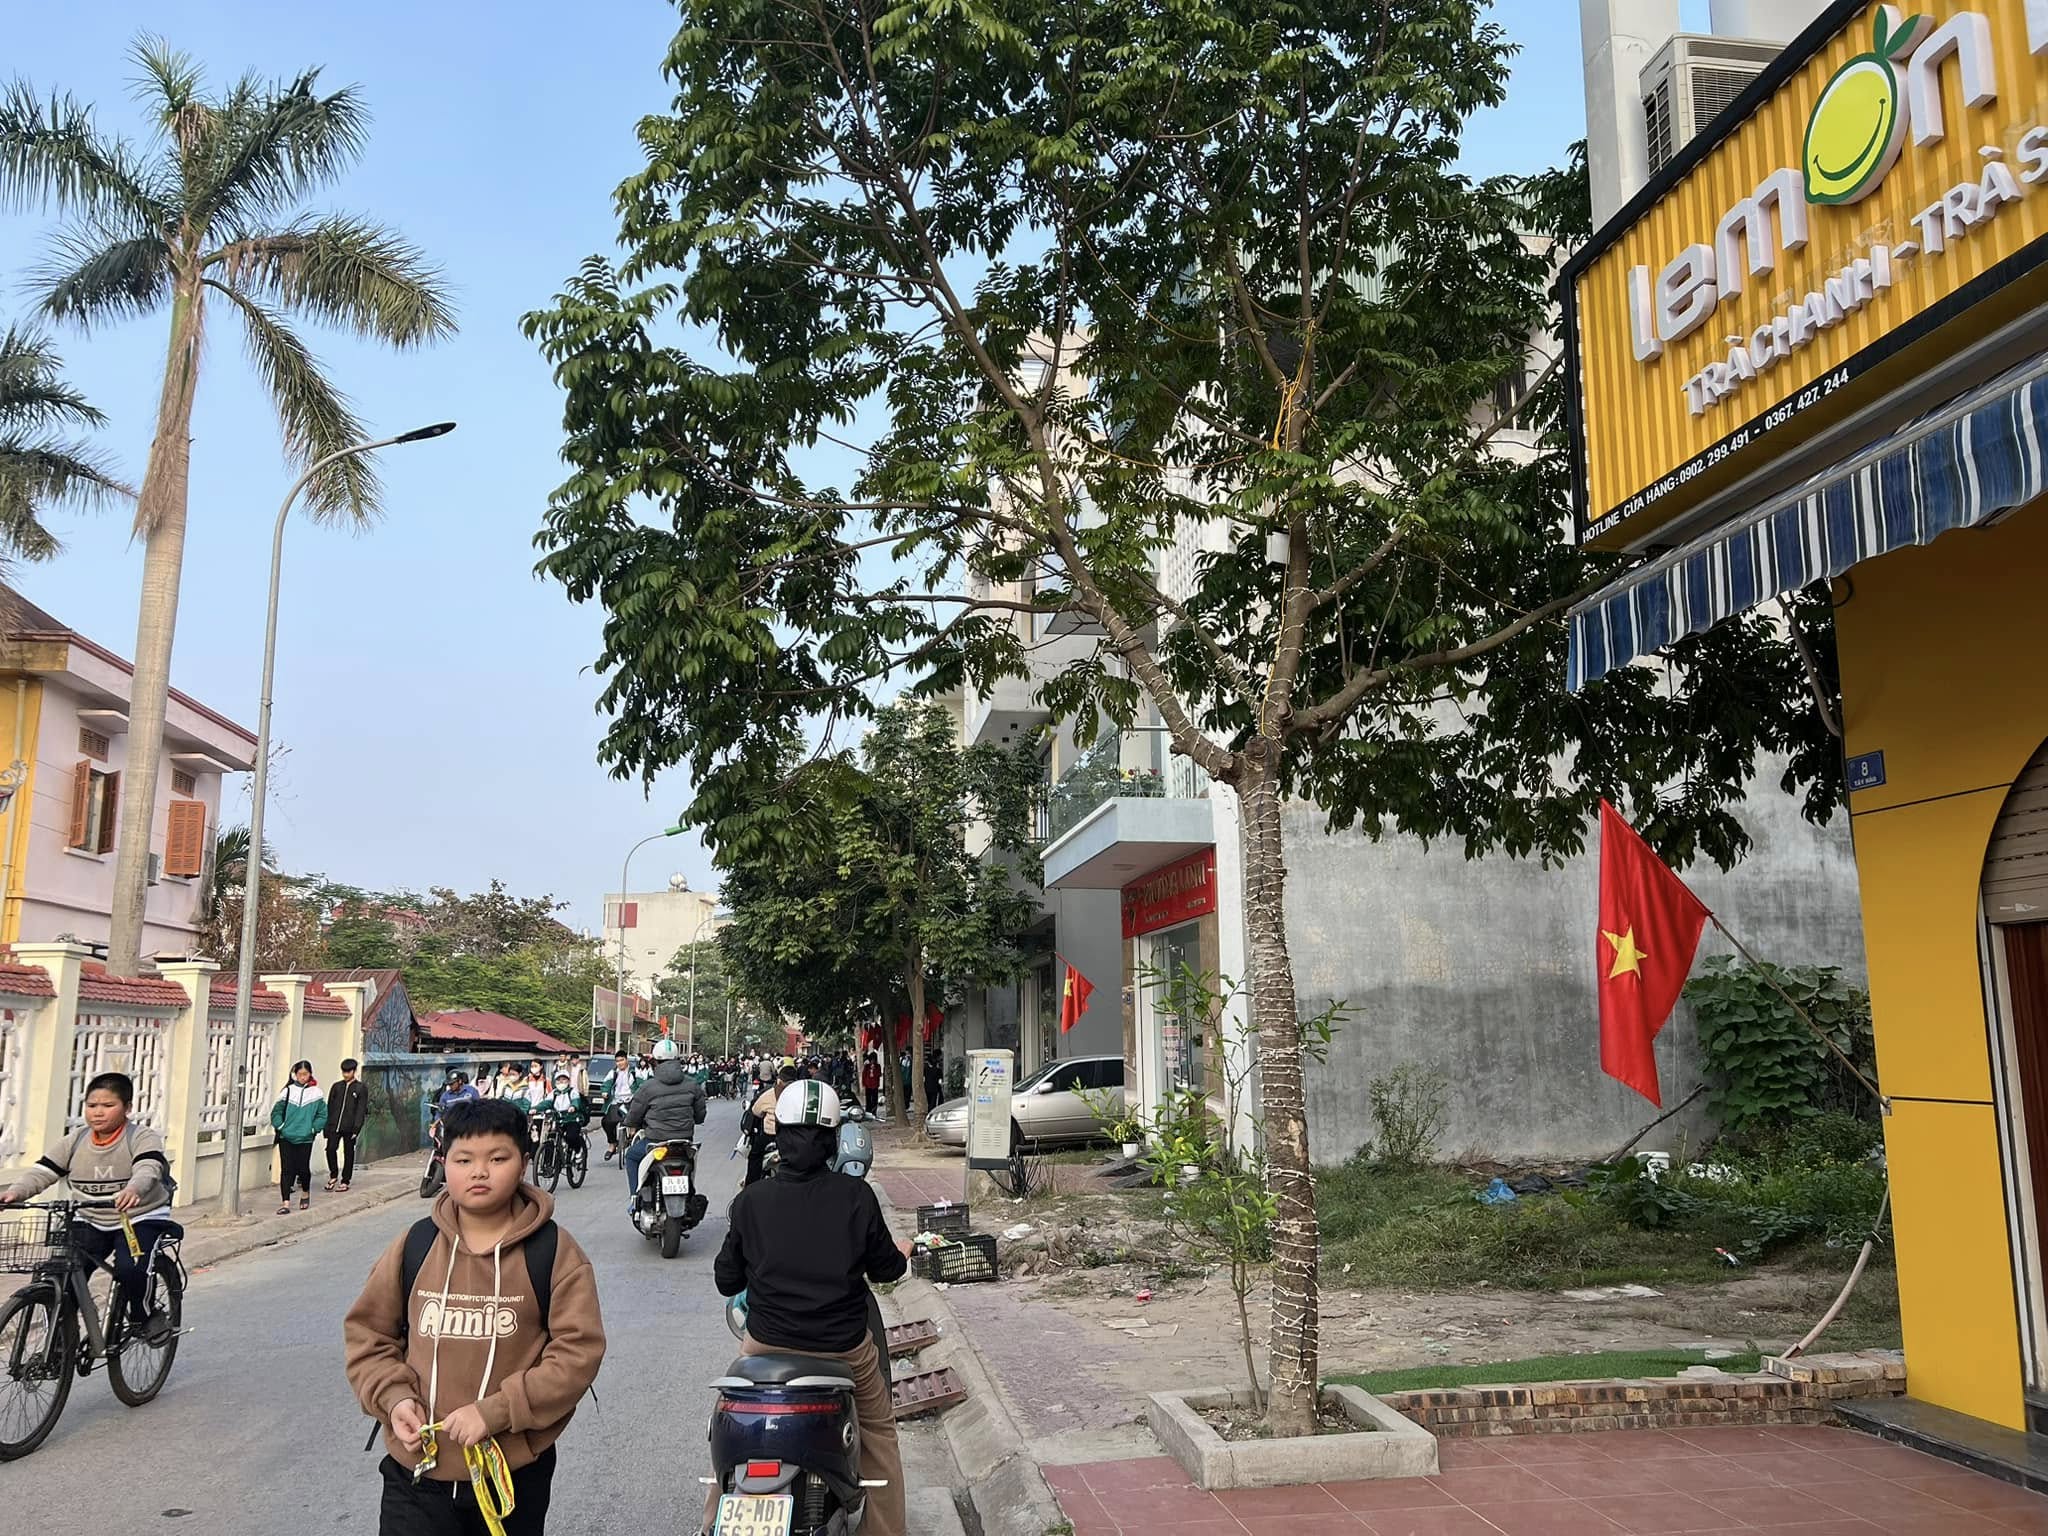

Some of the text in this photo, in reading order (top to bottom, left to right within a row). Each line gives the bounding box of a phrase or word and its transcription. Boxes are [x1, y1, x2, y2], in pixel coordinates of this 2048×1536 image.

[1911, 145, 2023, 255] TRÀ
[1582, 511, 1621, 543] HOTLINE
[1824, 368, 1849, 396] 244
[1861, 761, 1868, 776] 8
[94, 1165, 113, 1179] M
[418, 1299, 518, 1340] Annie
